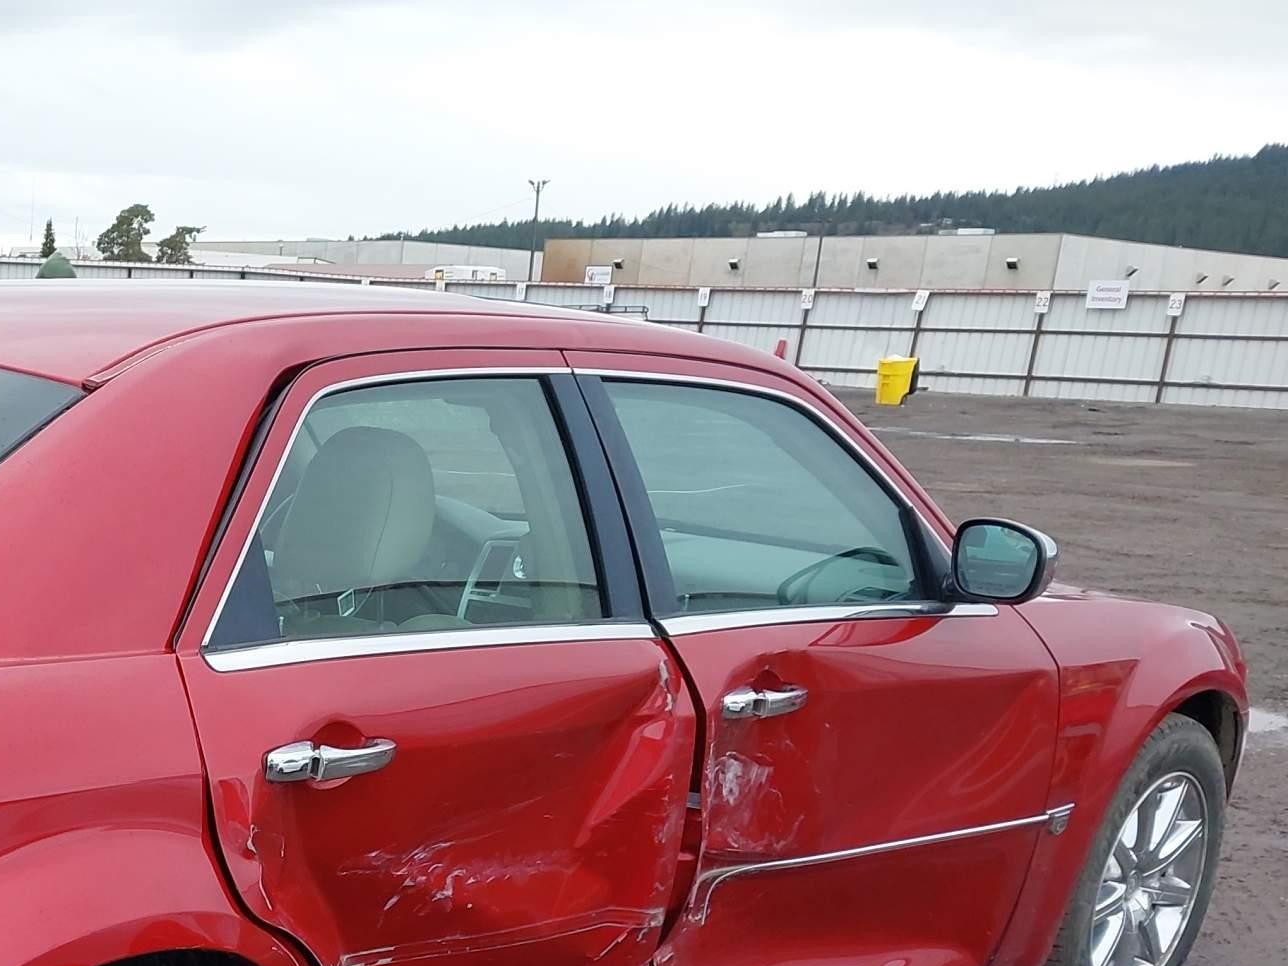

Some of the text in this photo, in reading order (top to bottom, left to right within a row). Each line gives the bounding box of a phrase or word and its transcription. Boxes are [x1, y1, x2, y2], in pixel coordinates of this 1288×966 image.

[801, 294, 813, 303] 20
[1036, 297, 1048, 306] 22
[1168, 299, 1183, 310] 23
